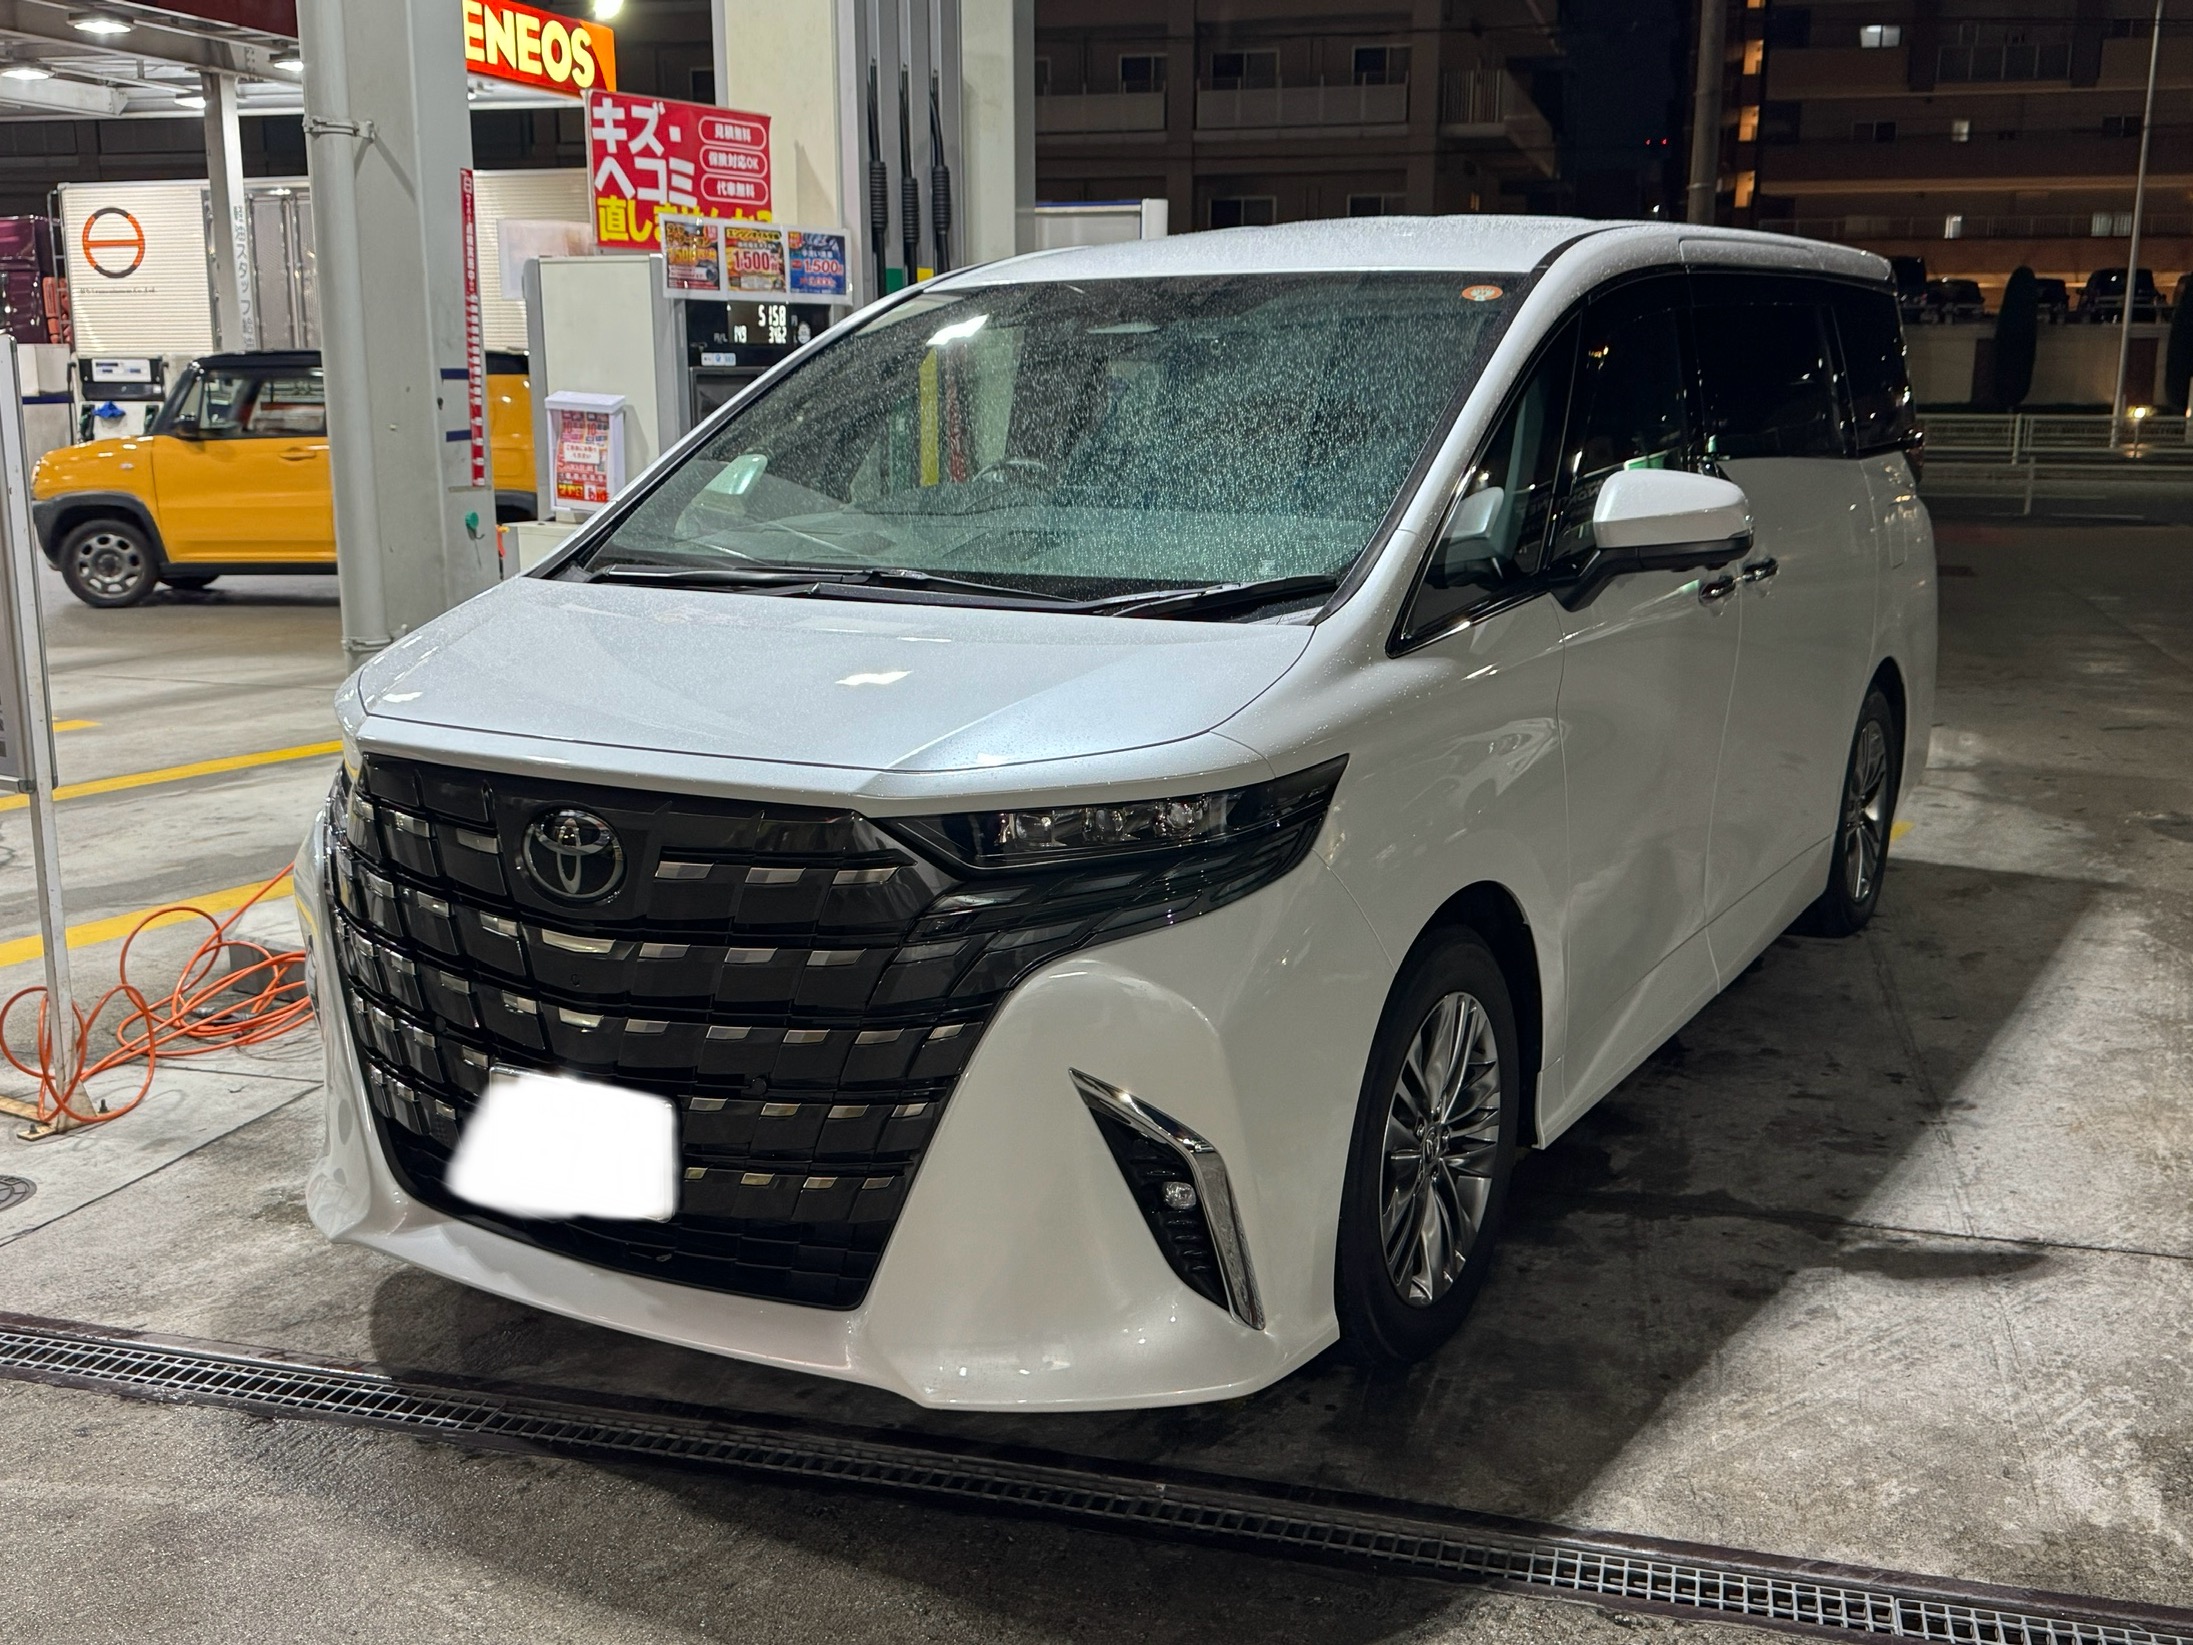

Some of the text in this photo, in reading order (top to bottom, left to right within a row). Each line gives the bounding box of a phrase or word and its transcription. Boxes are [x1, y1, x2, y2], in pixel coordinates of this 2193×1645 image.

[462, 0, 595, 88] ENEOS
[594, 156, 698, 207] ヘコミ
